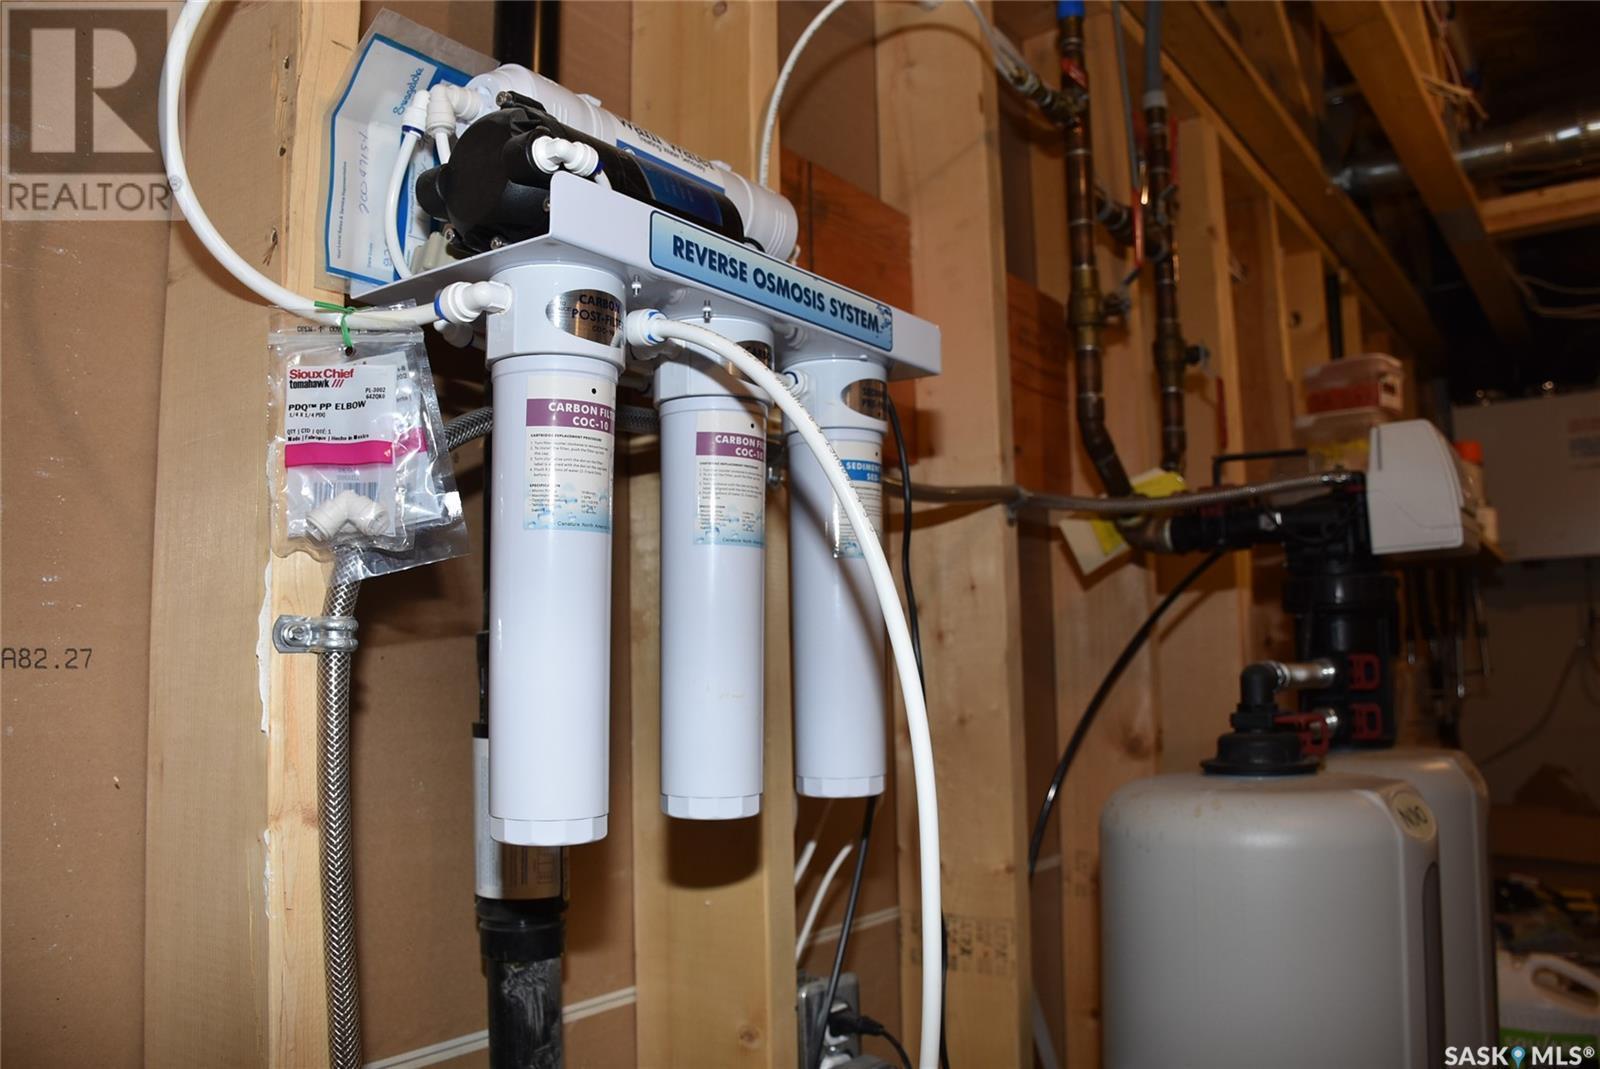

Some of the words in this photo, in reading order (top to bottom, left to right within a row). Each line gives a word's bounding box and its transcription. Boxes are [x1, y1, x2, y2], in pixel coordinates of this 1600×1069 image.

[672, 234, 748, 283] REVERSE
[753, 267, 826, 313] OSMOSIS
[830, 298, 880, 333] SYSTEM
[579, 294, 621, 314] CARBON
[289, 369, 322, 380] Sioux
[323, 368, 355, 379] Chief
[289, 379, 330, 389] tomahawk
[319, 403, 332, 411] PP
[334, 400, 367, 411] ELBOW
[548, 402, 598, 416] CARBON
[572, 416, 609, 431] COC-10
[715, 434, 756, 448] CARBON
[1, 647, 93, 669] A82.27
